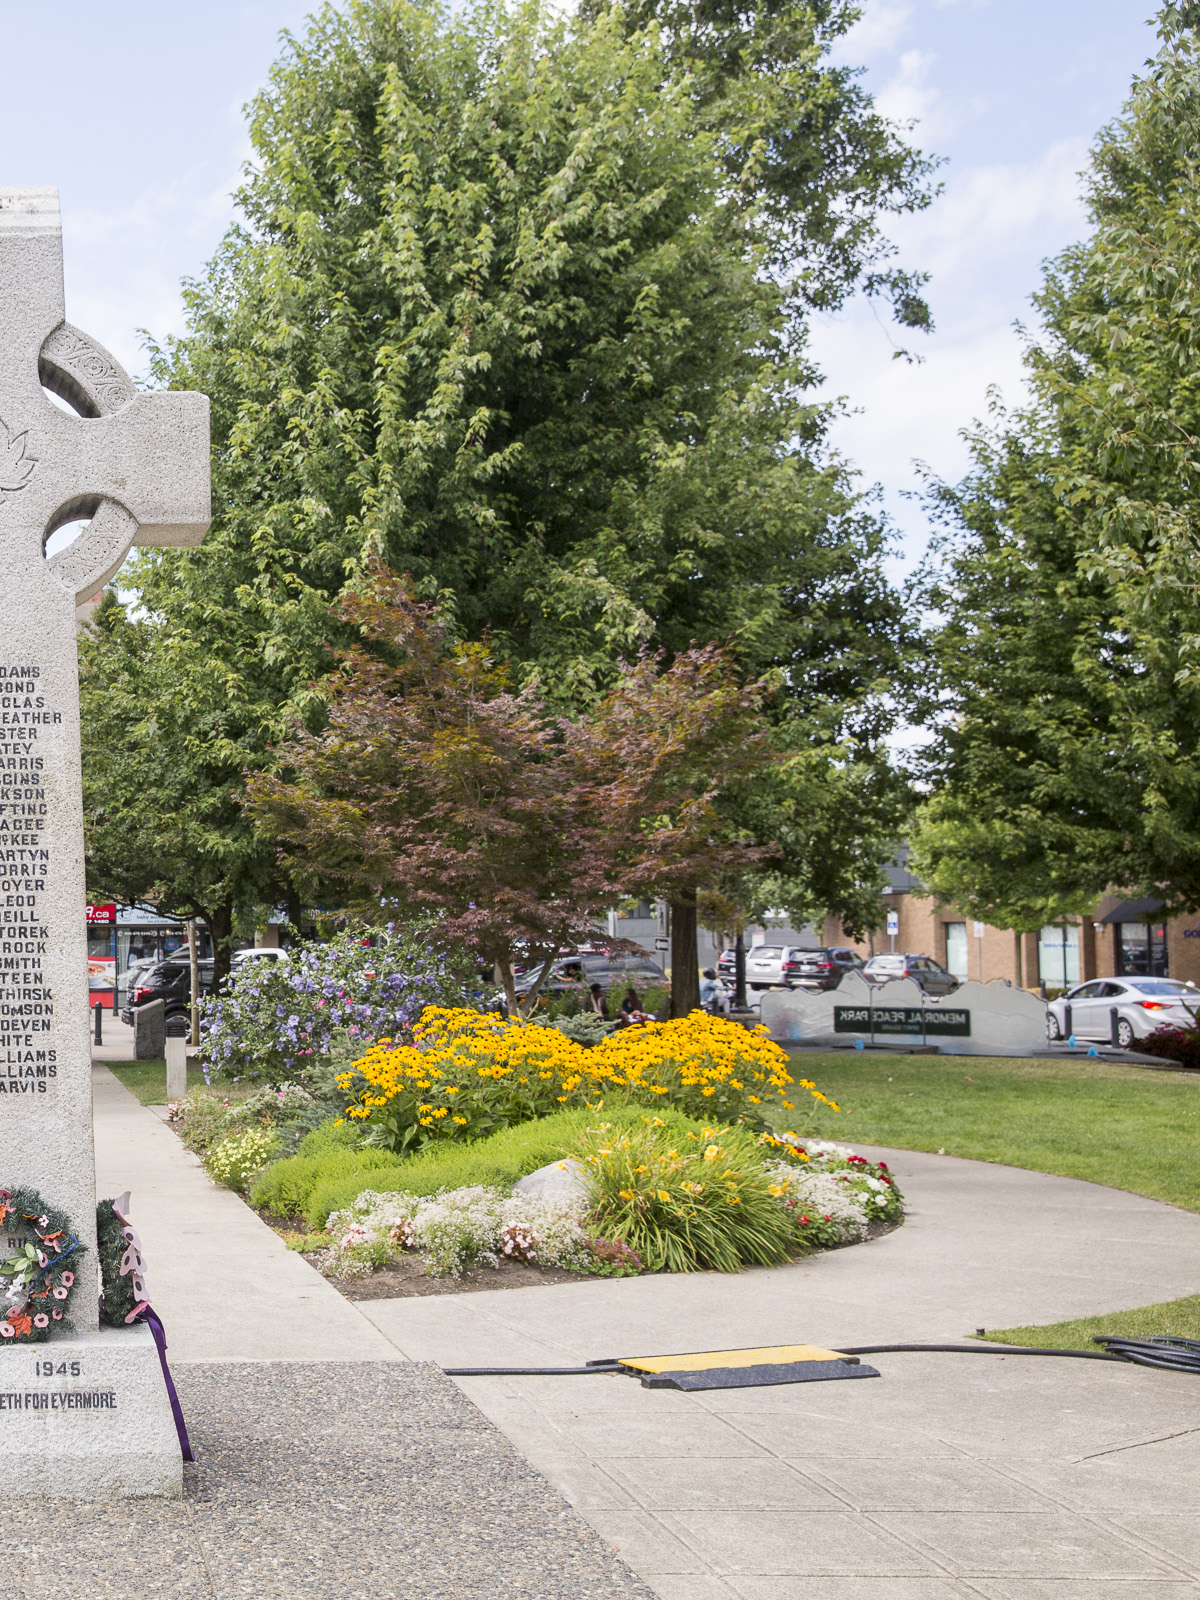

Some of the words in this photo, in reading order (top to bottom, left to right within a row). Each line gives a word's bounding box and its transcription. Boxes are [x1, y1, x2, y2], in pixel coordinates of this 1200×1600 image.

[35, 1361, 81, 1377] 1945
[24, 1393, 49, 1409] FOR
[51, 1392, 118, 1409] EVERMORE
